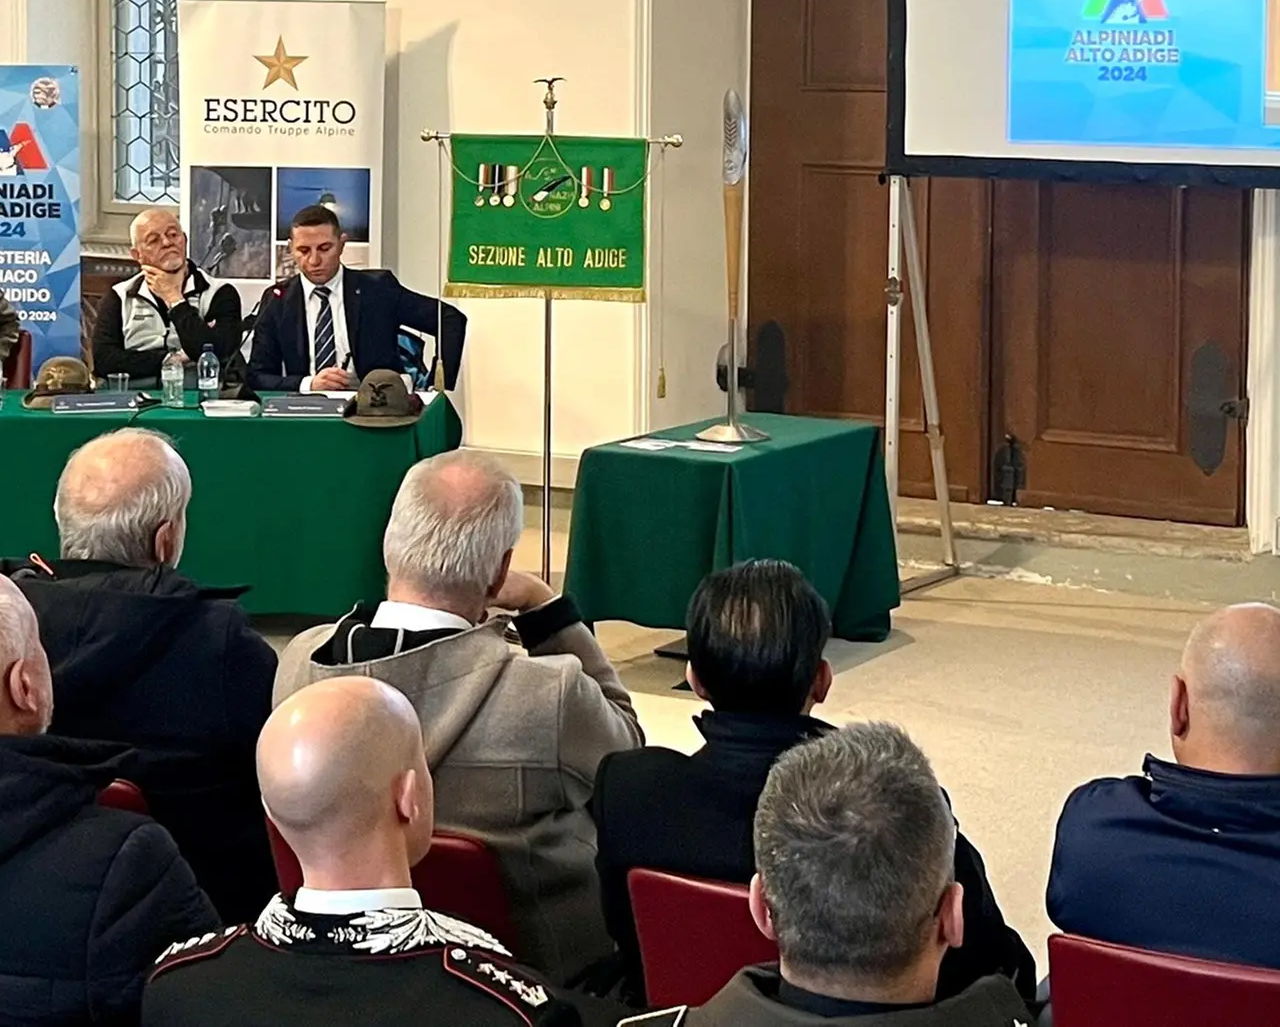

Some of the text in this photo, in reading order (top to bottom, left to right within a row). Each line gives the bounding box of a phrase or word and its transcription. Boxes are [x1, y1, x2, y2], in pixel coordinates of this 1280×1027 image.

[1072, 29, 1174, 46] ALPINIADI
[1065, 47, 1180, 63] ALTO ADIGE
[1098, 66, 1148, 81] 2024
[204, 98, 356, 125] ESERCITO
[204, 124, 356, 136] Comando Truppe Alpine
[469, 245, 627, 268] SEZIONE ALTO ADIGE
[27, 310, 57, 321] 2024
